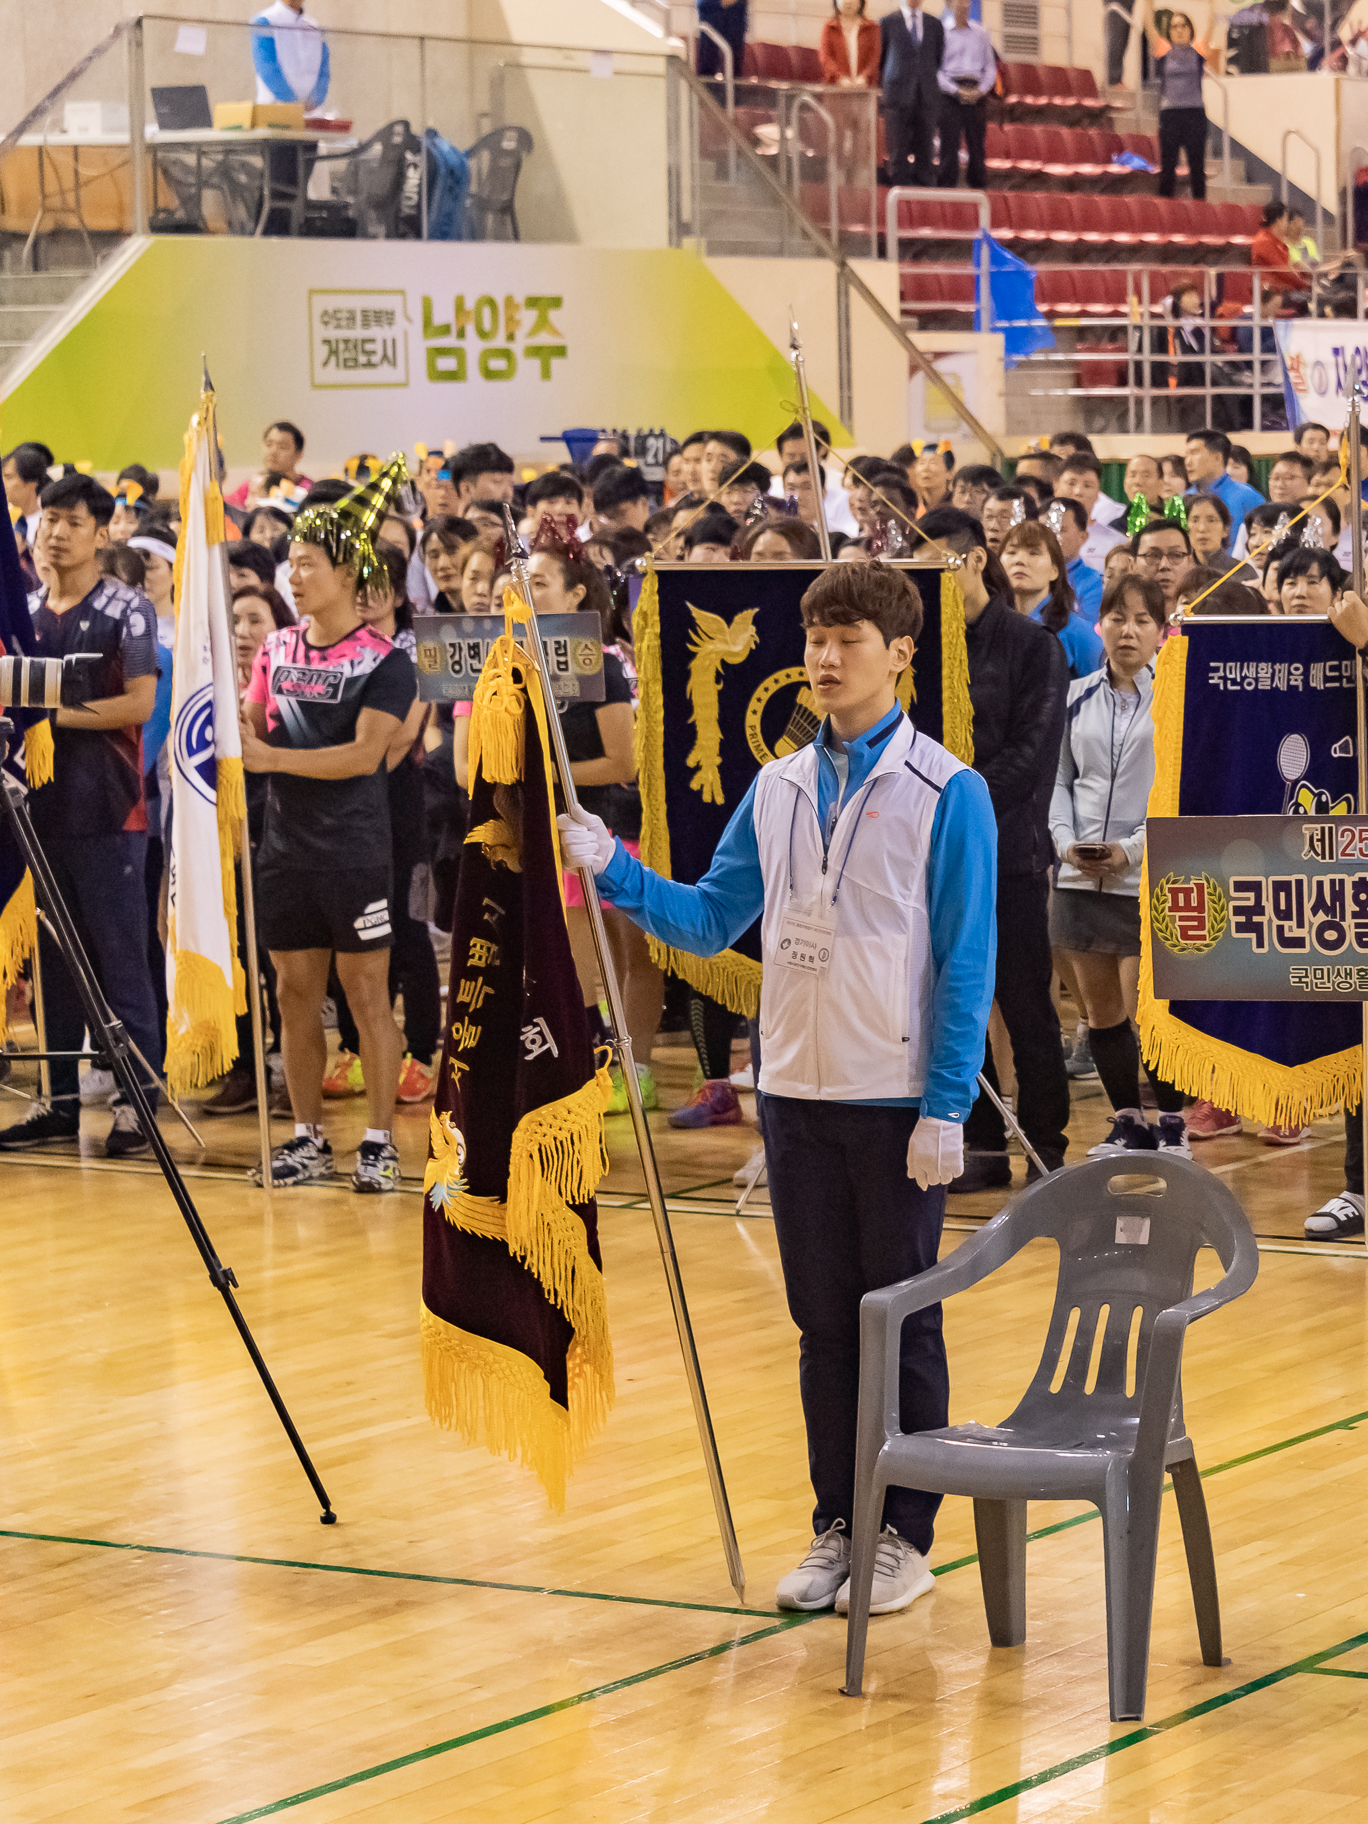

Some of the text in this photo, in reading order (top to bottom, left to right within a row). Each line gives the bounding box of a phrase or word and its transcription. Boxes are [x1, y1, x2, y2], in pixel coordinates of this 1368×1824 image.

[319, 309, 357, 329] 수도권
[322, 337, 397, 369] 거점도시
[421, 294, 568, 383] 남양주
[646, 437, 664, 465] 21
[1208, 662, 1304, 691] 국민생활체육
[748, 724, 769, 762] PRIME
[1167, 878, 1207, 943] 필
[520, 1016, 559, 1061] 회
